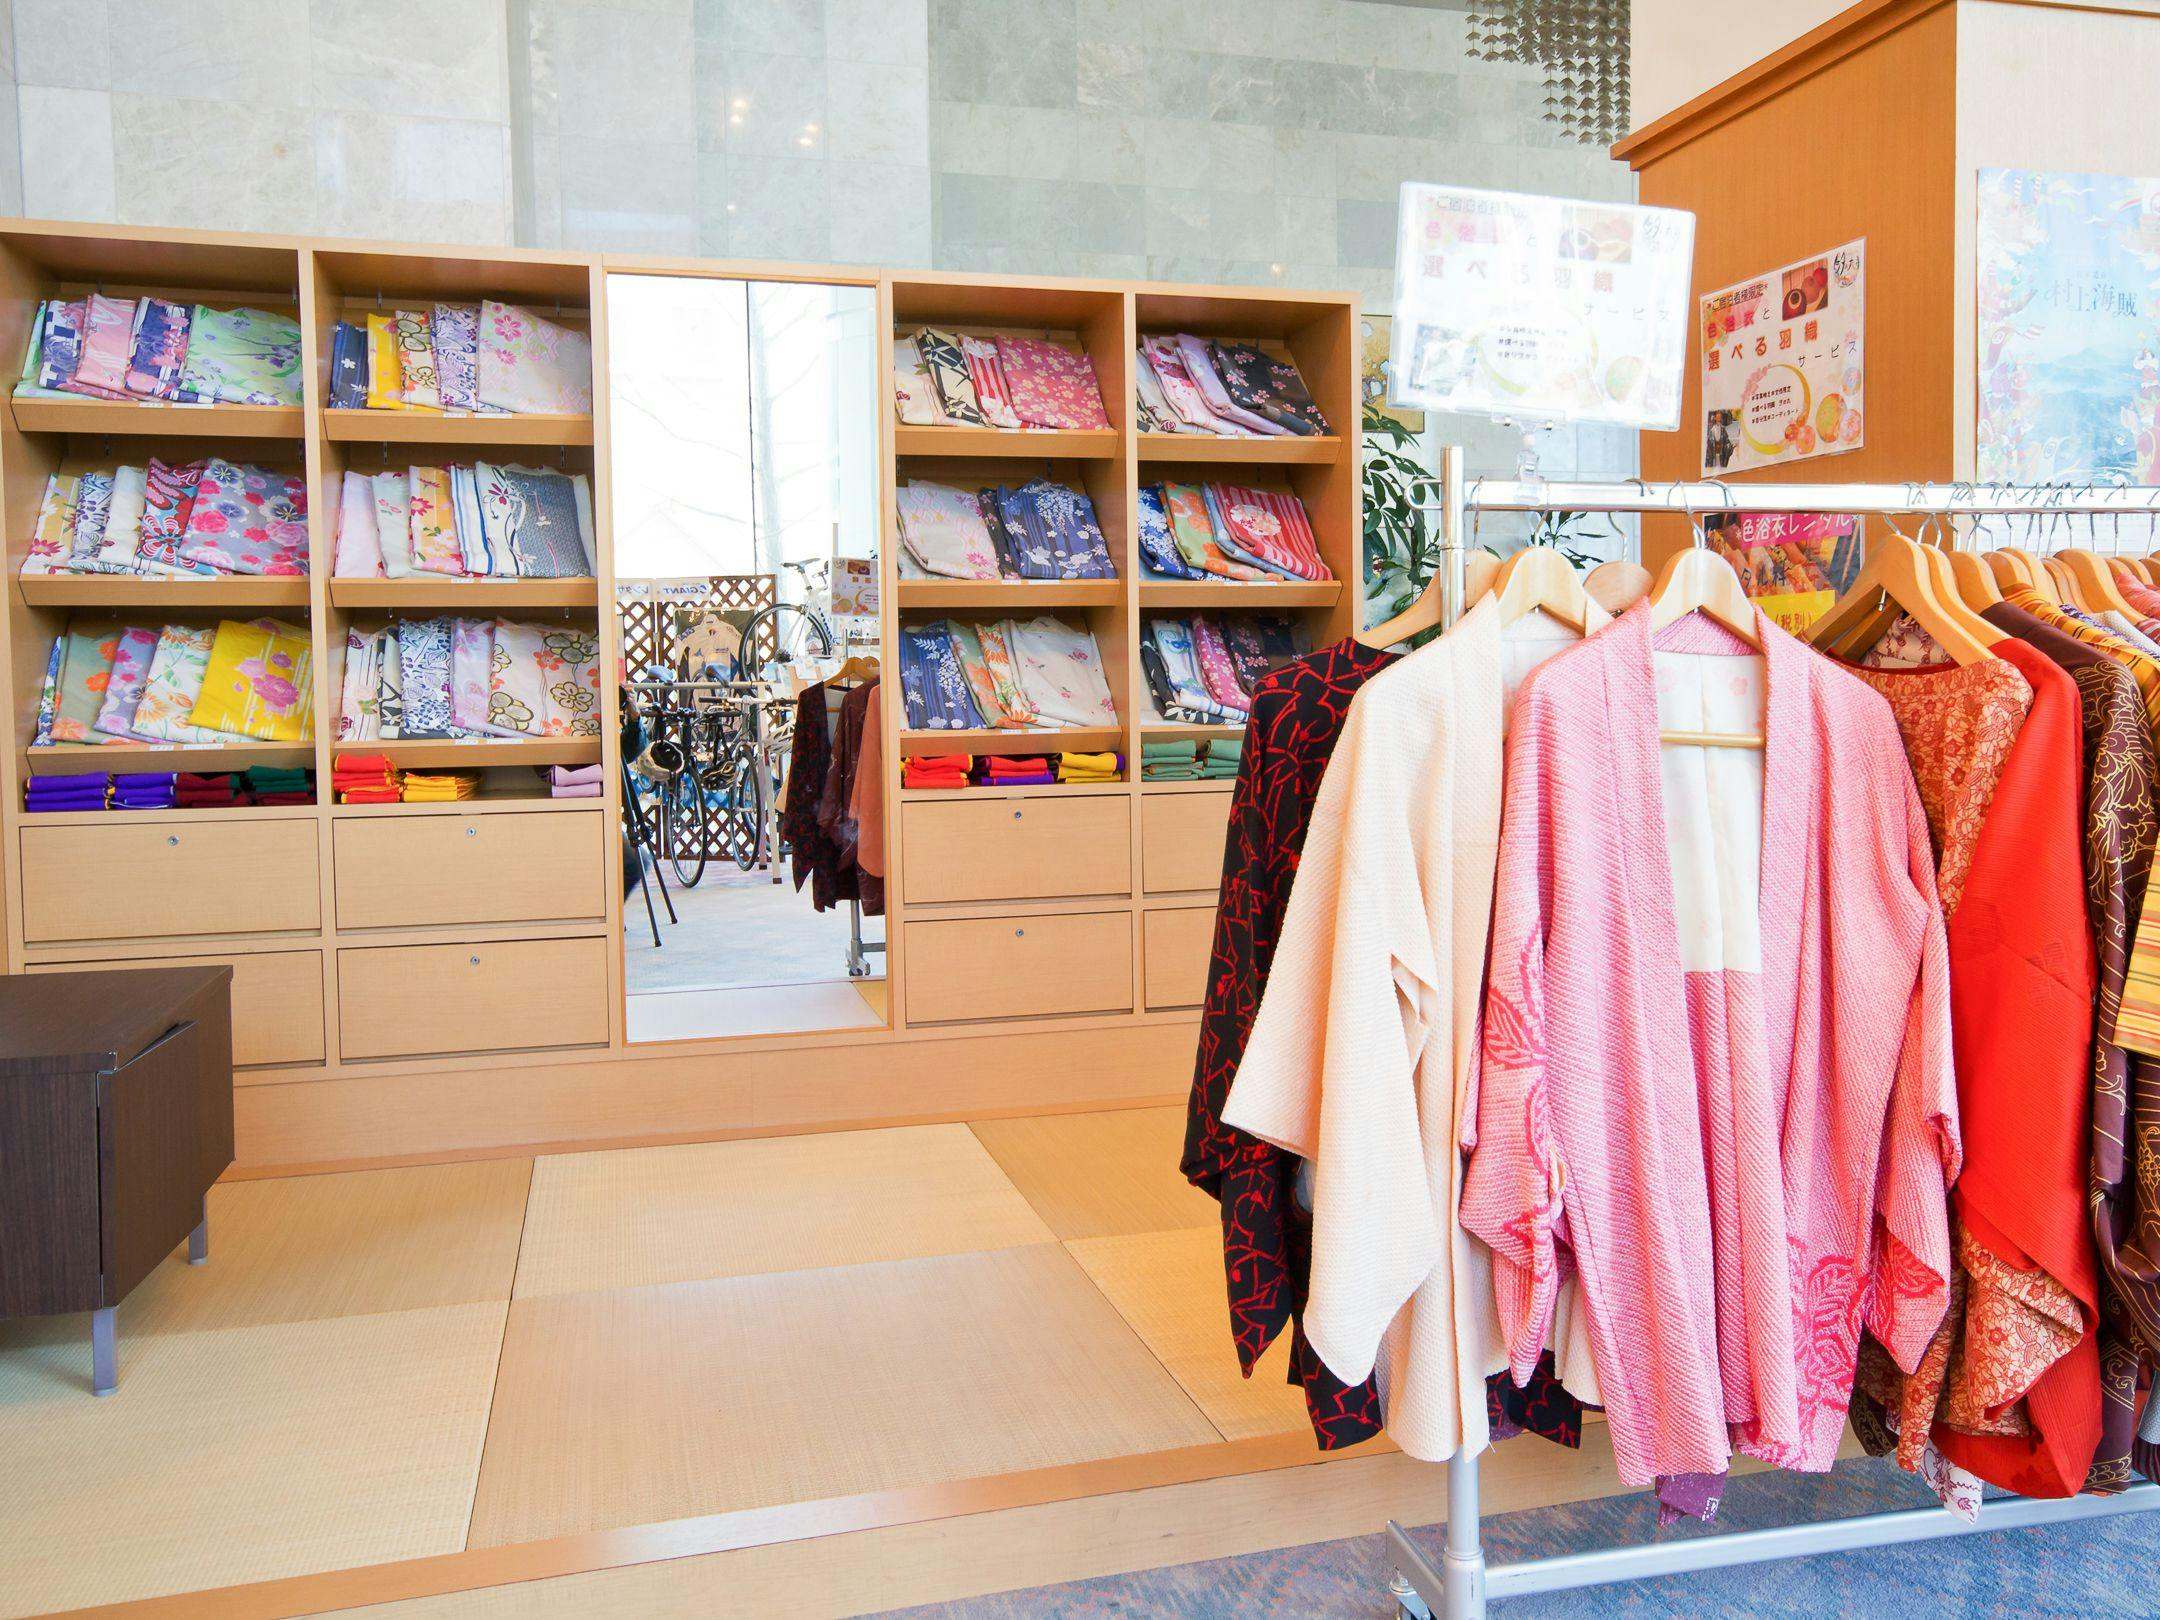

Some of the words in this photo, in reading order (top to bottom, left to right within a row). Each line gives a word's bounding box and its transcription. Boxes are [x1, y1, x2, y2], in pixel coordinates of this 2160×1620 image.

[2048, 278, 2138, 318] 村上海賊
[1708, 319, 1819, 371] 選べる羽織
[1797, 340, 1857, 368] サービス
